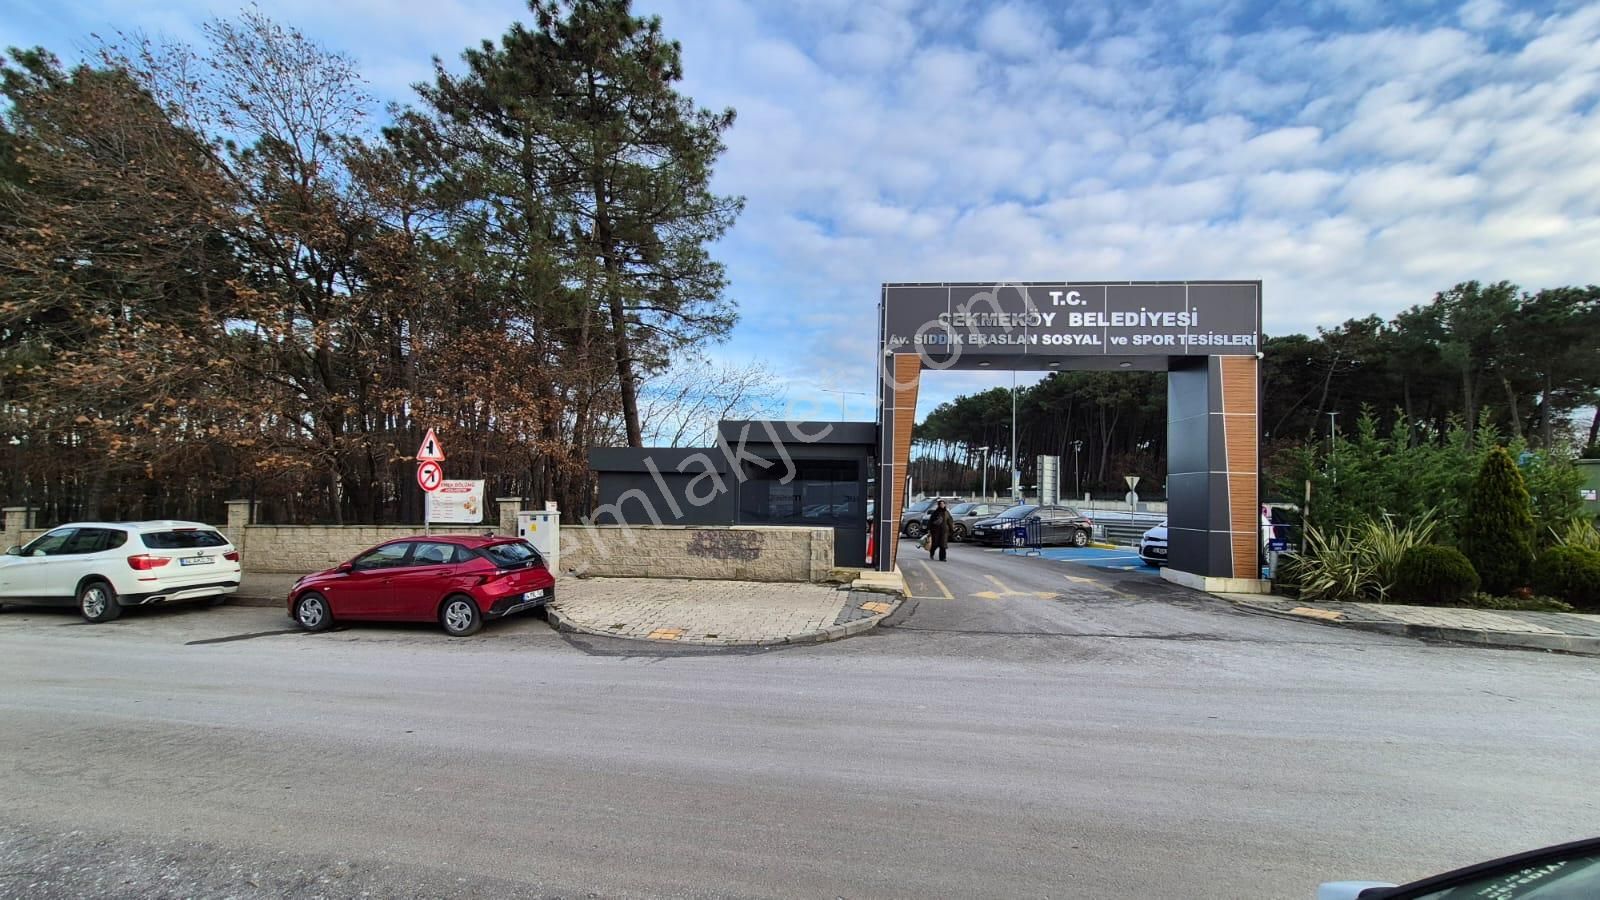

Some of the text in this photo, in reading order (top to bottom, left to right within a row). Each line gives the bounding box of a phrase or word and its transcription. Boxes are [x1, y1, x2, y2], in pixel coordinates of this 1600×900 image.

[1049, 291, 1087, 306] T.C.
[1069, 307, 1197, 327] BELEDİYESİ
[889, 331, 1257, 346] Av. SIDDIK ERASLAN SOSYAL ve SPOR TESİSLERİ
